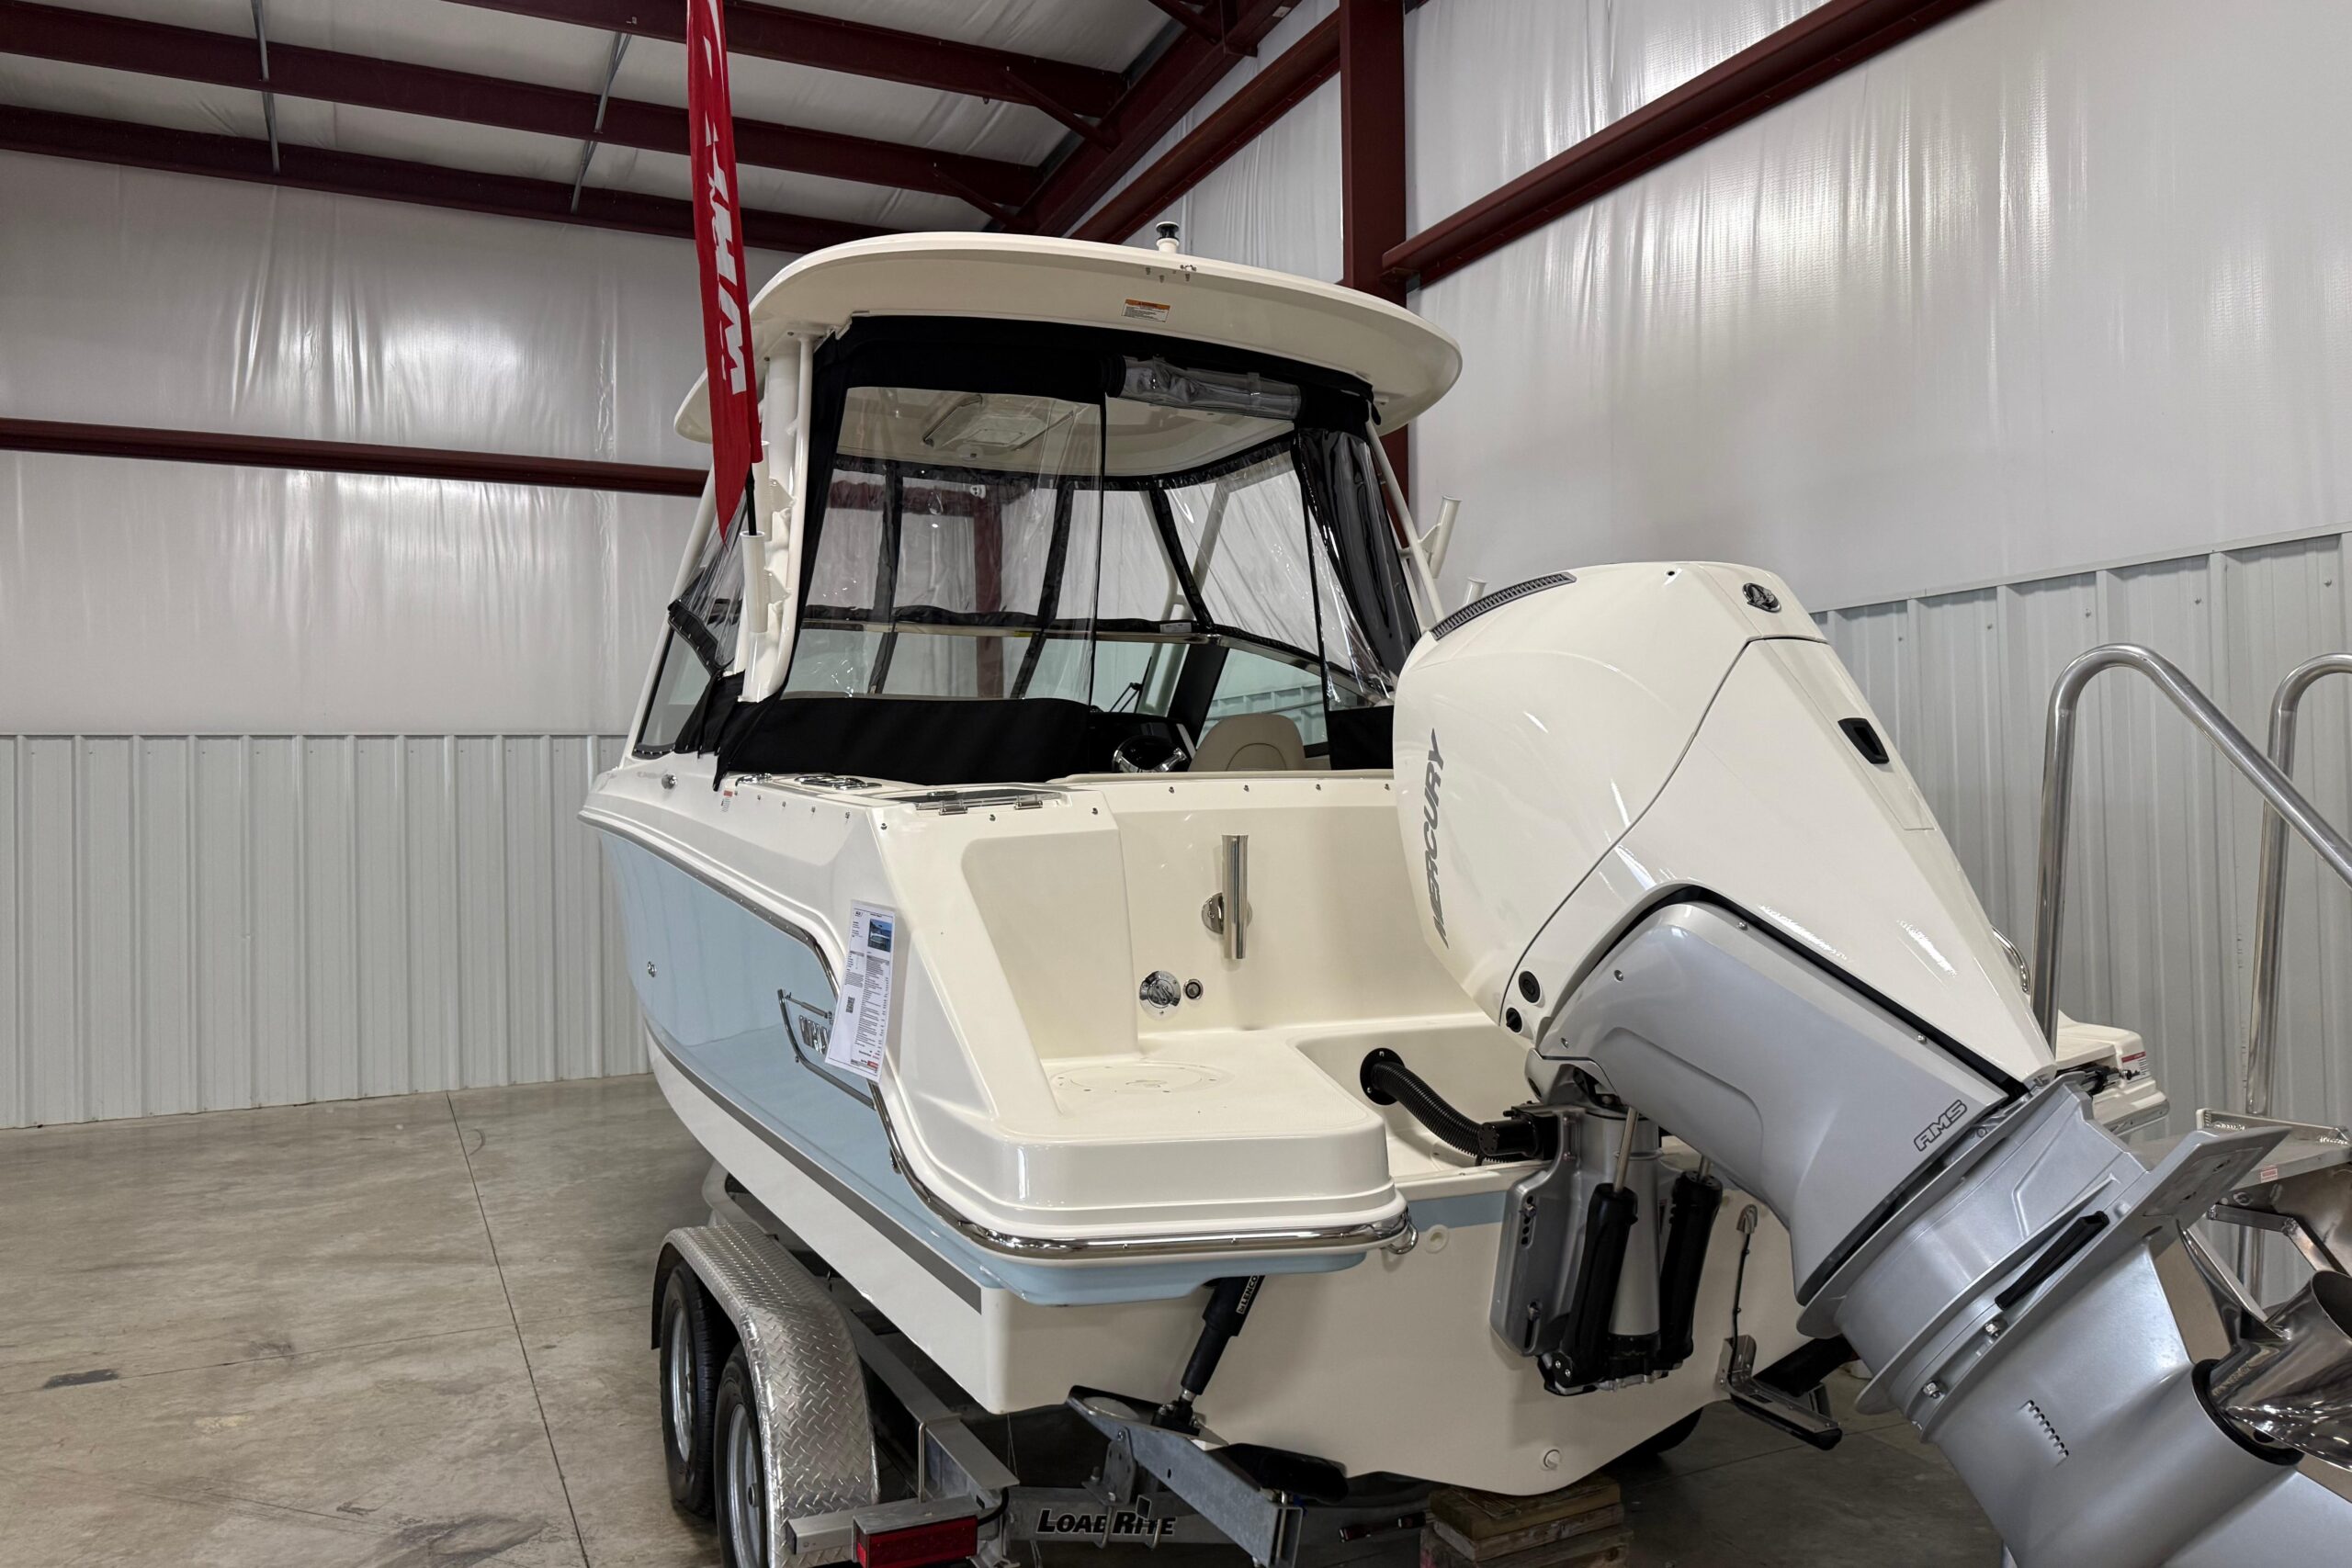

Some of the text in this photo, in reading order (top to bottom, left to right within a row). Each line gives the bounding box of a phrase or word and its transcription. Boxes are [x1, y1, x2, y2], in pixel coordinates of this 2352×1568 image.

[1423, 727, 1449, 950] MERCURY
[1914, 1099, 1967, 1152] AMS
[1240, 1275, 1258, 1305] LENCO
